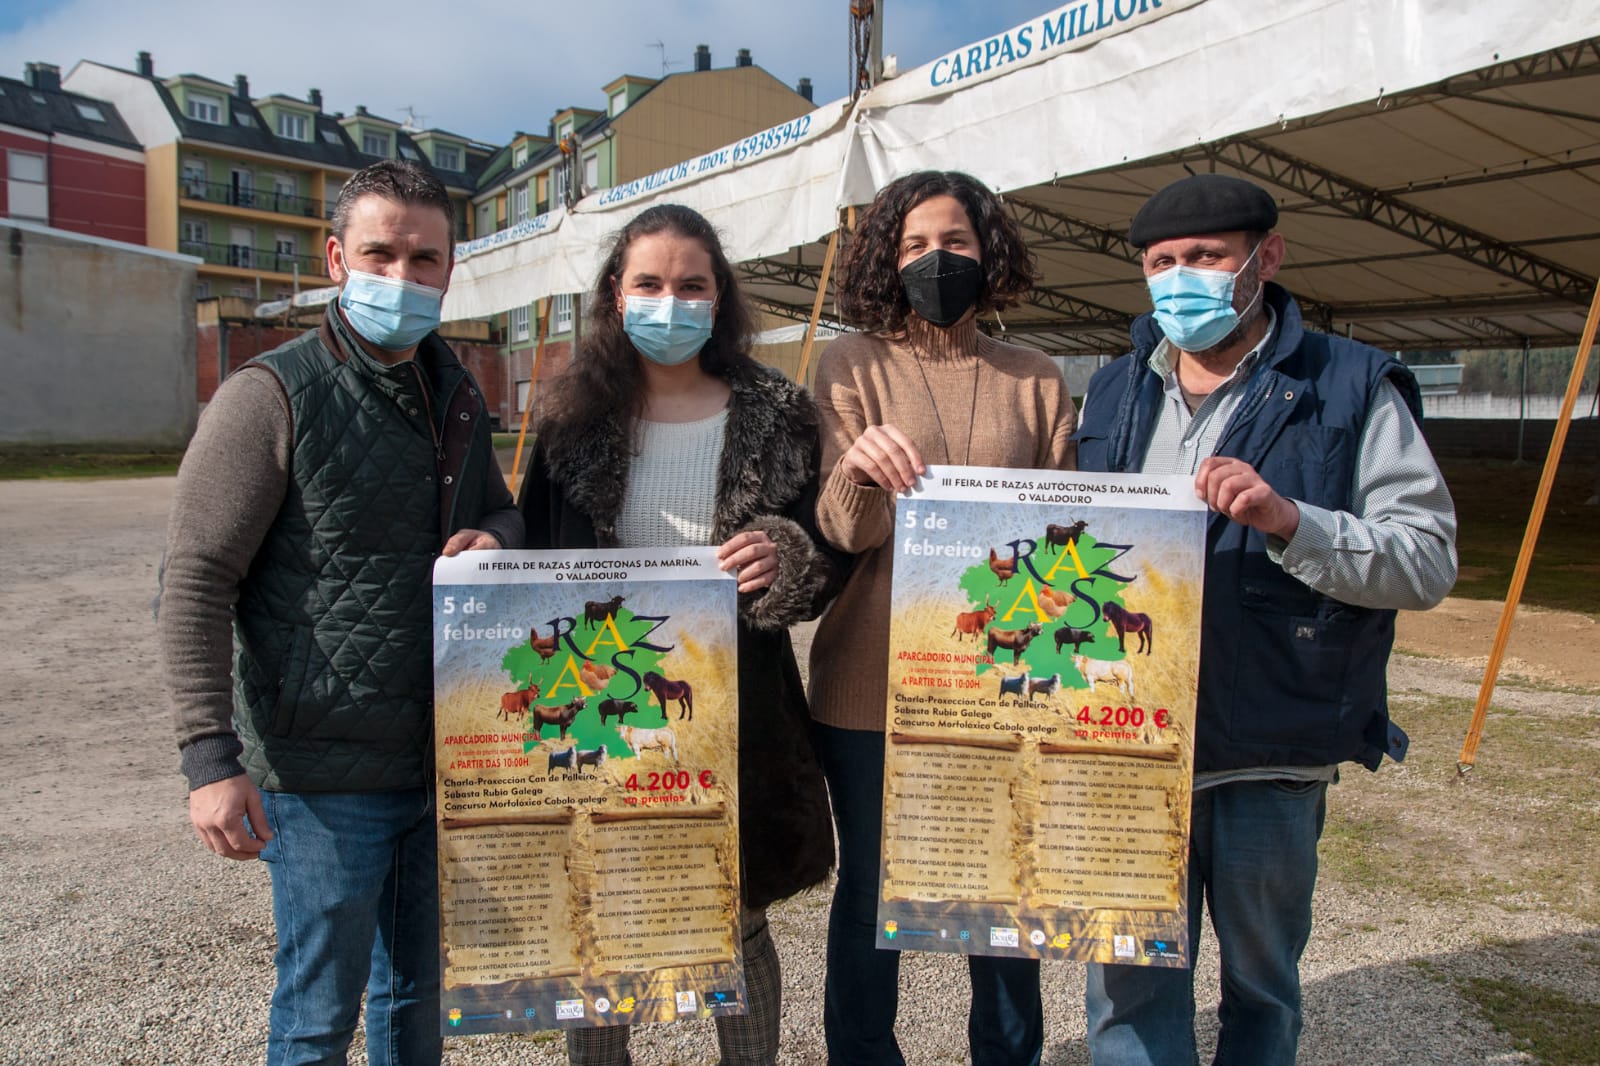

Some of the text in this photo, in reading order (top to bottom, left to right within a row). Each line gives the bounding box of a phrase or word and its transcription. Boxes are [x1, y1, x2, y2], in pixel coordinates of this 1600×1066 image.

[931, 26, 1032, 87] CARPAS
[641, 160, 690, 192] MILLOR
[733, 115, 811, 162] 659385942
[955, 479, 982, 487] FEIRA
[1001, 482, 1034, 490] RAZAS
[1036, 481, 1107, 493] AUTÓCTONAS
[1111, 485, 1124, 493] DA
[1127, 484, 1170, 495] MARIÑA.
[1030, 494, 1092, 504] VALADOURO
[904, 511, 948, 530] 5 de
[904, 539, 982, 558] febreiro
[492, 562, 520, 570] FEIRA
[574, 559, 641, 569] AUTÓCTONAS
[660, 557, 701, 567] MARIÑA.
[567, 572, 627, 580] VALADOURO
[443, 596, 487, 614] 5 de
[443, 623, 523, 640] febreiro
[898, 652, 995, 665] APARCADOIRO MUNICIPAL
[902, 677, 980, 689] A PARTIR DAS 10:00H
[979, 698, 996, 706] Can
[1000, 700, 1010, 708] de
[1013, 700, 1049, 710] Palleiro,
[933, 708, 958, 717] Rubia
[961, 710, 992, 720] Galega
[1076, 705, 1169, 728] 4.200 €
[894, 718, 934, 728] Concurso
[993, 722, 1024, 731] Cabalo
[1028, 724, 1058, 734] galego
[444, 733, 541, 745] APARCADOIRO MUNICIPAL
[1092, 730, 1137, 740] premios
[449, 757, 529, 769] A PARTIR DAS 10:00H
[444, 773, 597, 787] Charla-Proxección Can de Palleiro,
[625, 770, 712, 791] 4.200 €
[483, 788, 508, 797] Rubia
[511, 787, 543, 797] Galega
[445, 802, 486, 811] Concurso
[545, 797, 576, 806] Cabalo
[578, 796, 607, 806] galego
[641, 794, 684, 805] premios
